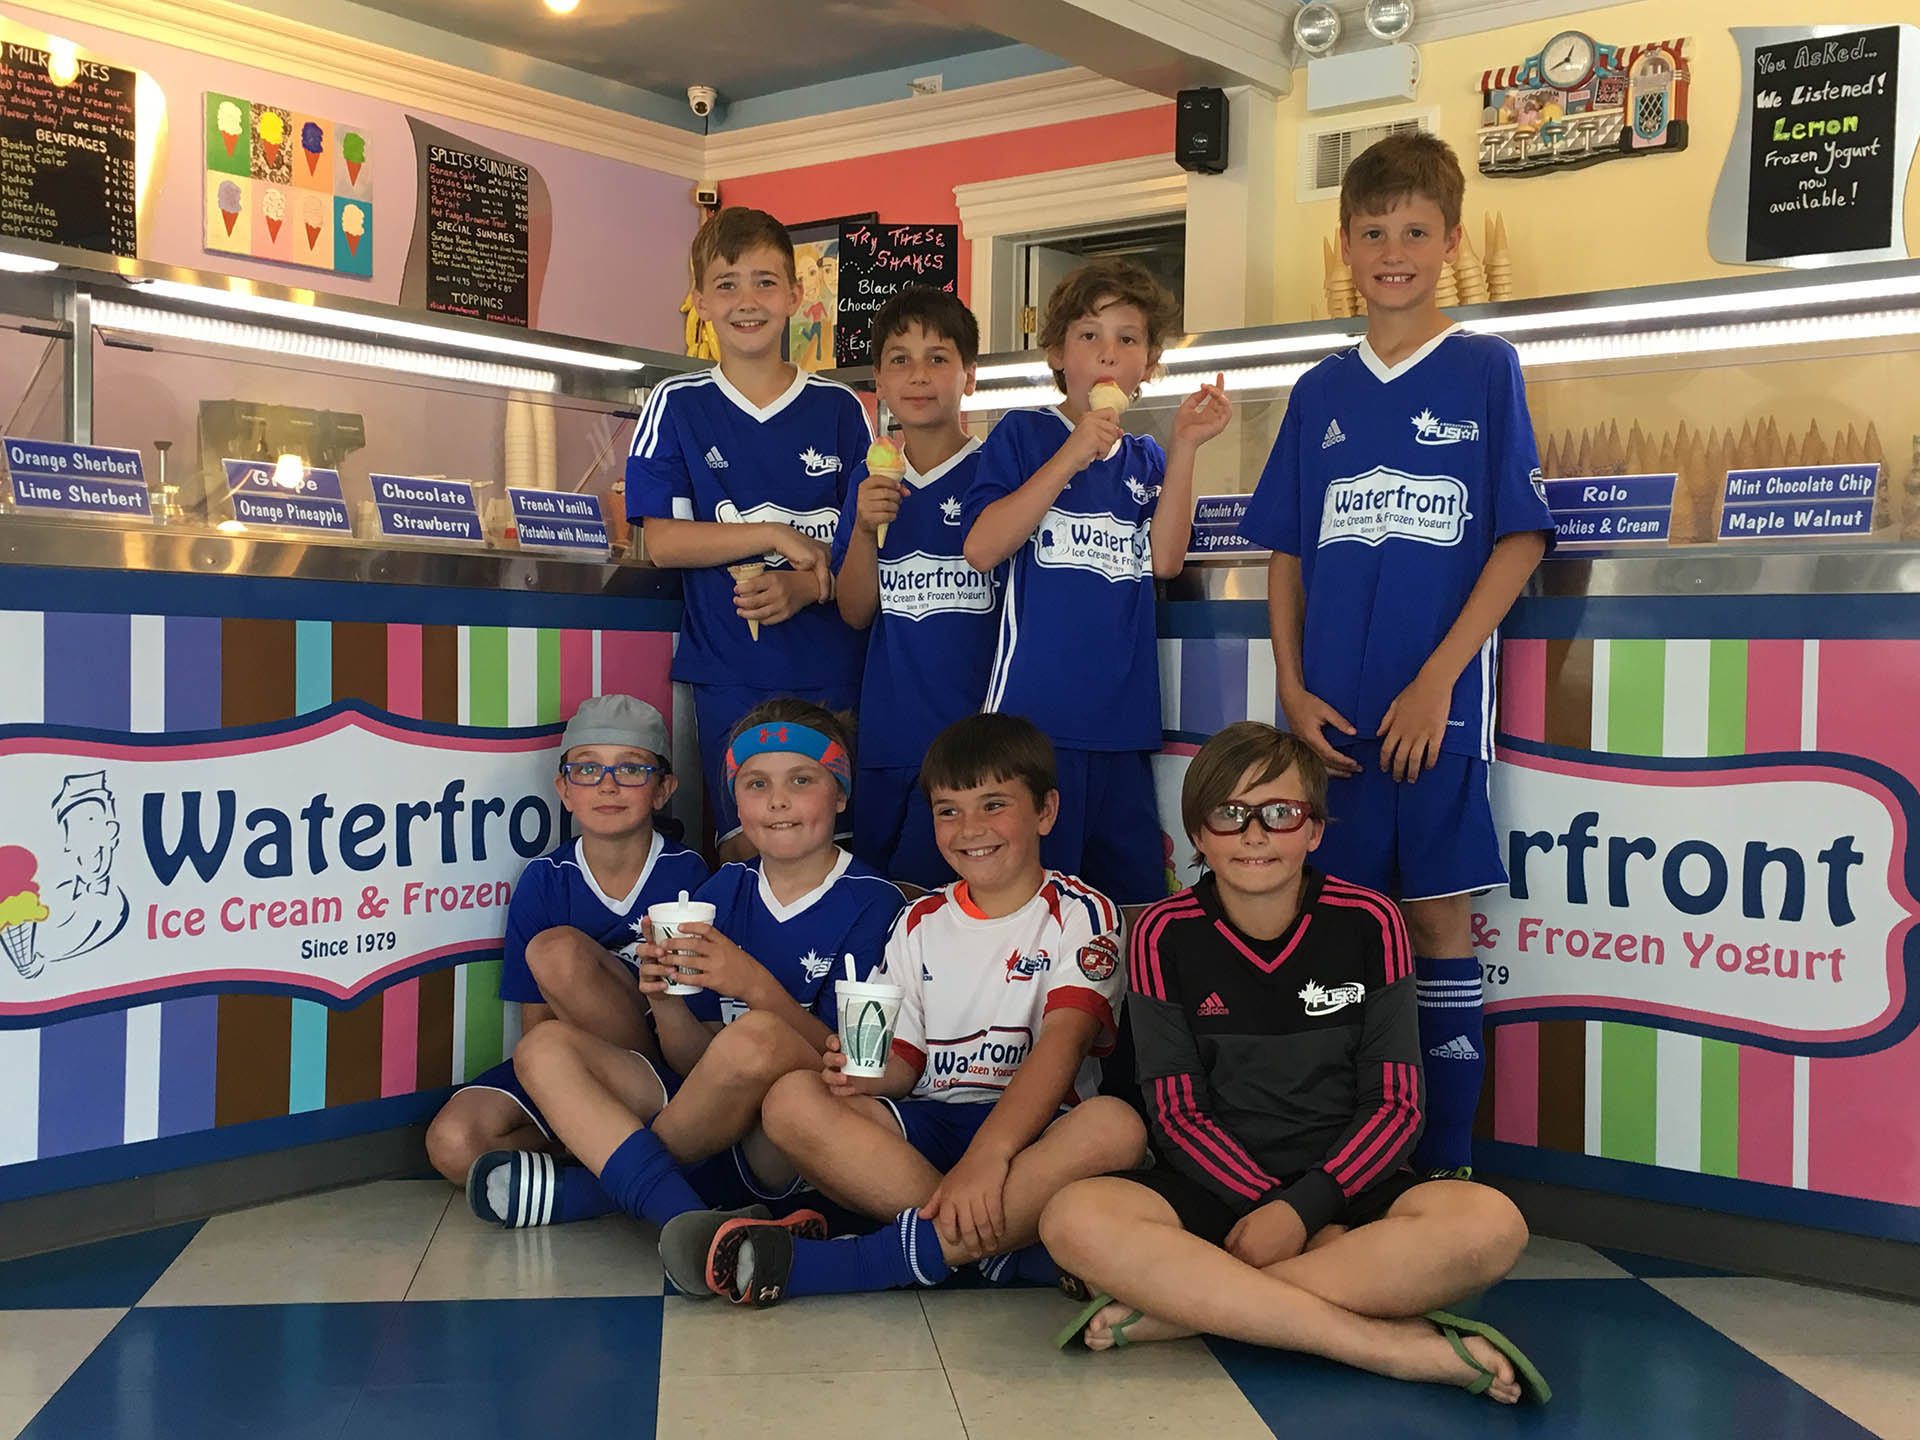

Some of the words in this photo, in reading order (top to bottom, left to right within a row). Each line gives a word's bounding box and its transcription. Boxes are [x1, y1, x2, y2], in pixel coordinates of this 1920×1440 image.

[1757, 52, 1787, 75] You
[1756, 89, 1783, 109] We
[1790, 71, 1887, 106] Listened!
[1772, 115, 1859, 142] Lemon
[36, 128, 107, 153] BEVERAGES
[36, 144, 67, 157] Cooler
[2, 160, 36, 174] Floats
[34, 153, 68, 167] Cooler
[430, 147, 473, 169] SPLITS
[479, 158, 528, 182] SUNDAES
[1764, 149, 1818, 168] Frozen
[1814, 137, 1881, 175] Yogurt
[0, 171, 34, 186] Sodas
[430, 175, 462, 189] Sundae
[1798, 177, 1827, 191] now
[2, 184, 30, 199] Malts
[440, 187, 472, 202] Sisters
[436, 220, 472, 236] SPECIAL
[476, 227, 515, 244] SUNDAES
[874, 249, 945, 275] SHAKES
[857, 278, 898, 295] Black
[451, 291, 504, 311] TOPPINGS
[11, 447, 67, 473] Orange
[72, 451, 139, 475] Sherbert
[18, 481, 62, 502] Lime
[68, 484, 143, 509] Sherbert
[382, 482, 466, 506] Chocolate
[1583, 484, 1628, 503] Rolo
[1728, 475, 1762, 496] Mint
[1765, 472, 1834, 495] Chocolate
[1840, 473, 1873, 495] Chip
[519, 495, 555, 514] French
[557, 499, 594, 517] Vanilla
[1198, 503, 1232, 518] Chocolate
[1335, 485, 1457, 516] Waterfront
[240, 499, 283, 523] Orange
[286, 503, 344, 526] Pineapple
[1333, 516, 1346, 529] Ice
[1347, 515, 1373, 527] Cream
[1375, 514, 1383, 523] &
[1384, 511, 1414, 527] Frozen
[1418, 517, 1451, 530] Yogurt
[1728, 511, 1785, 534] Maple
[1793, 508, 1864, 529] Walnut
[393, 512, 471, 537] Strawberry
[519, 522, 556, 541] Pistachio
[557, 529, 574, 543] with
[575, 528, 608, 545] Almonds
[1554, 518, 1596, 536] ookies
[1600, 517, 1612, 535] &
[1616, 516, 1660, 534] Cream
[1072, 548, 1085, 558] Ice
[1087, 549, 1111, 562] Cream
[1113, 555, 1119, 565] &
[893, 593, 916, 604] Cream
[917, 592, 925, 601] &
[927, 591, 955, 601] Frozen
[957, 591, 986, 601] Yogurt
[1509, 811, 1864, 927] rfront
[147, 903, 205, 940] Ice
[220, 896, 342, 932] Cream
[357, 885, 389, 919] &
[403, 880, 511, 915] Frozen
[301, 938, 348, 960] Since
[355, 931, 396, 954] 1979
[1518, 918, 1665, 966] Frozen
[1683, 931, 1846, 983] Yogurt
[1479, 963, 1509, 985] 79
[1197, 1006, 1229, 1016] adidas
[864, 1059, 874, 1068] 12
[1429, 1049, 1480, 1061] adidas
[933, 1078, 947, 1089] Ice
